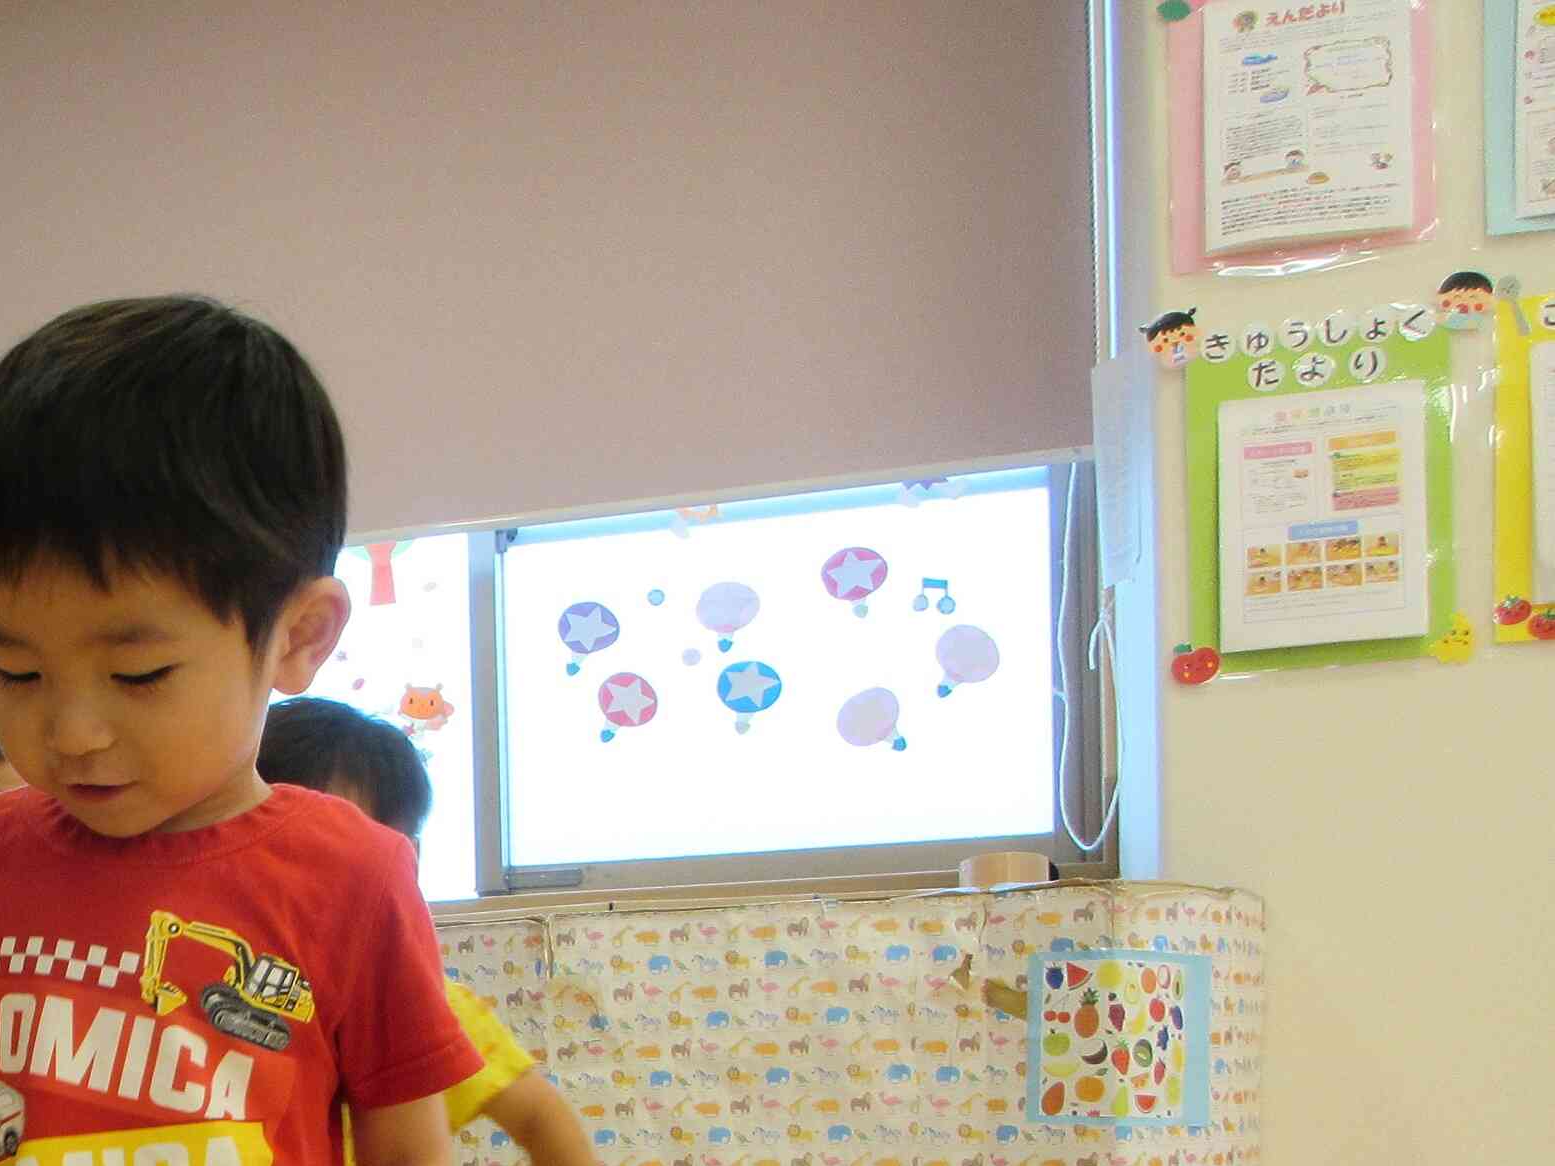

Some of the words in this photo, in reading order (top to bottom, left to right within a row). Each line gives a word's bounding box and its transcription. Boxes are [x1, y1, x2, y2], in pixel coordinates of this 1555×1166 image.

[1205, 310, 1426, 359] きゅうしょく
[1252, 350, 1379, 388] だより
